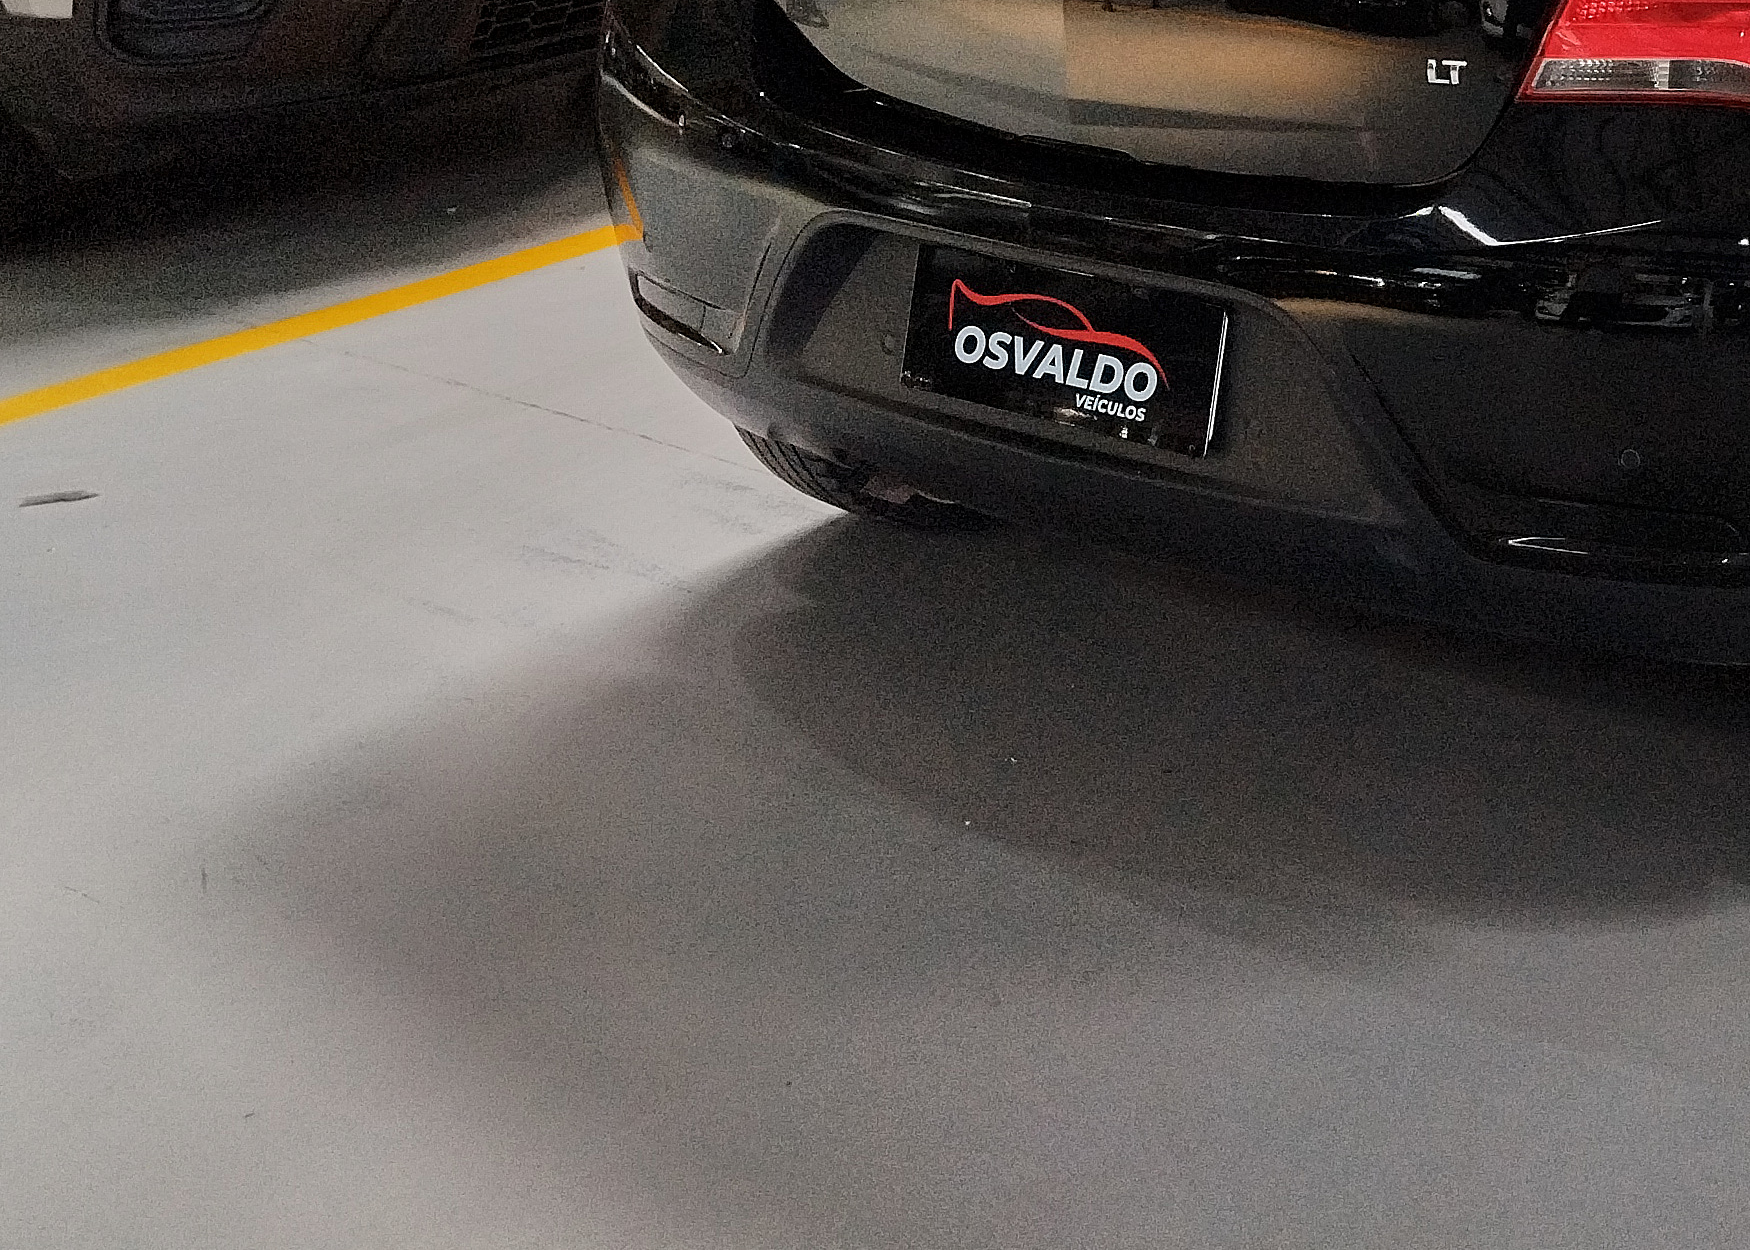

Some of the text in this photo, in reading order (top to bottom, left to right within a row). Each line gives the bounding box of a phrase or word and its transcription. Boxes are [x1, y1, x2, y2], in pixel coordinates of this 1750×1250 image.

[1427, 58, 1467, 85] LT
[954, 325, 1158, 402] OSVALDO
[1075, 392, 1147, 422] VEÍCULOS
